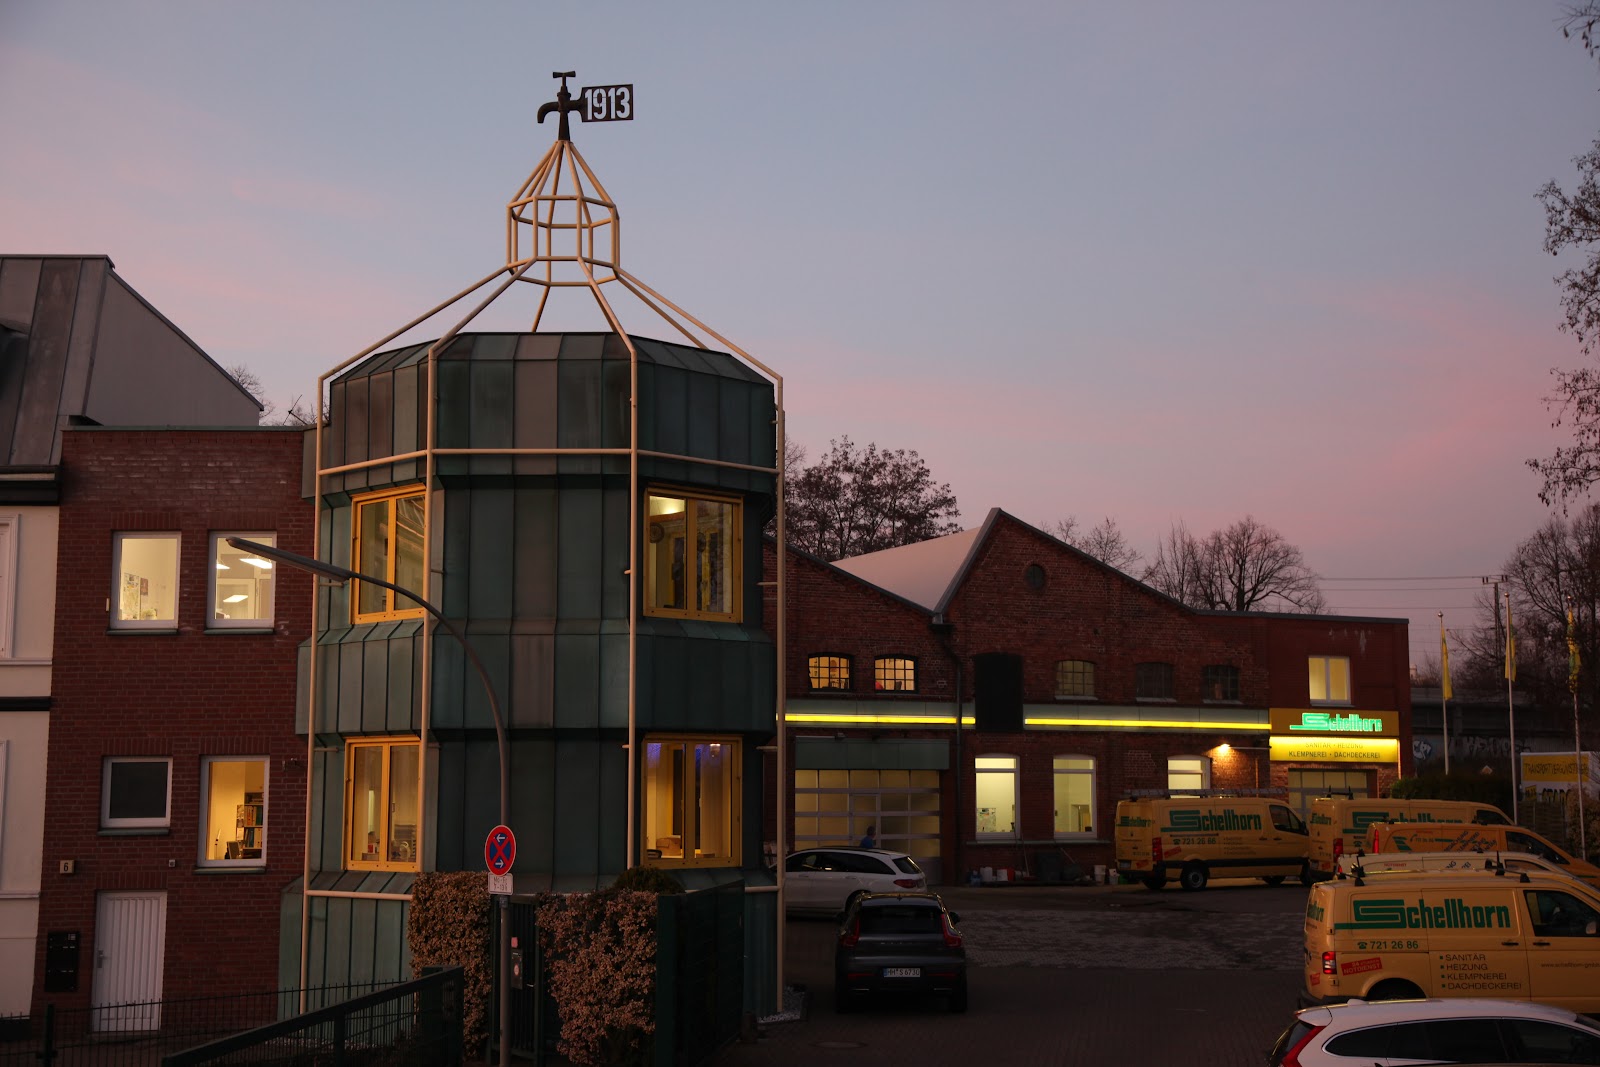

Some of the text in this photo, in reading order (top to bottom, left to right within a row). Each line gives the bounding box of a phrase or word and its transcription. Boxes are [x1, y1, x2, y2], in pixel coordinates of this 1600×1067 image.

[585, 87, 630, 120] 1913
[1290, 713, 1383, 732] Schellhorn
[1288, 750, 1381, 759] KLEMPNEREI DACHDECKEREI
[1161, 809, 1262, 832] Schellhorn
[1334, 899, 1511, 929] Schellhorn
[1370, 941, 1419, 949] 721 26 86
[1446, 953, 1486, 961] SANITÄR
[1343, 963, 1380, 974] NOTDIENST
[1446, 963, 1488, 971] HEIZUNG
[1447, 973, 1507, 981] KLEMPNEREI
[1448, 982, 1522, 990] DACHDECKEREI
